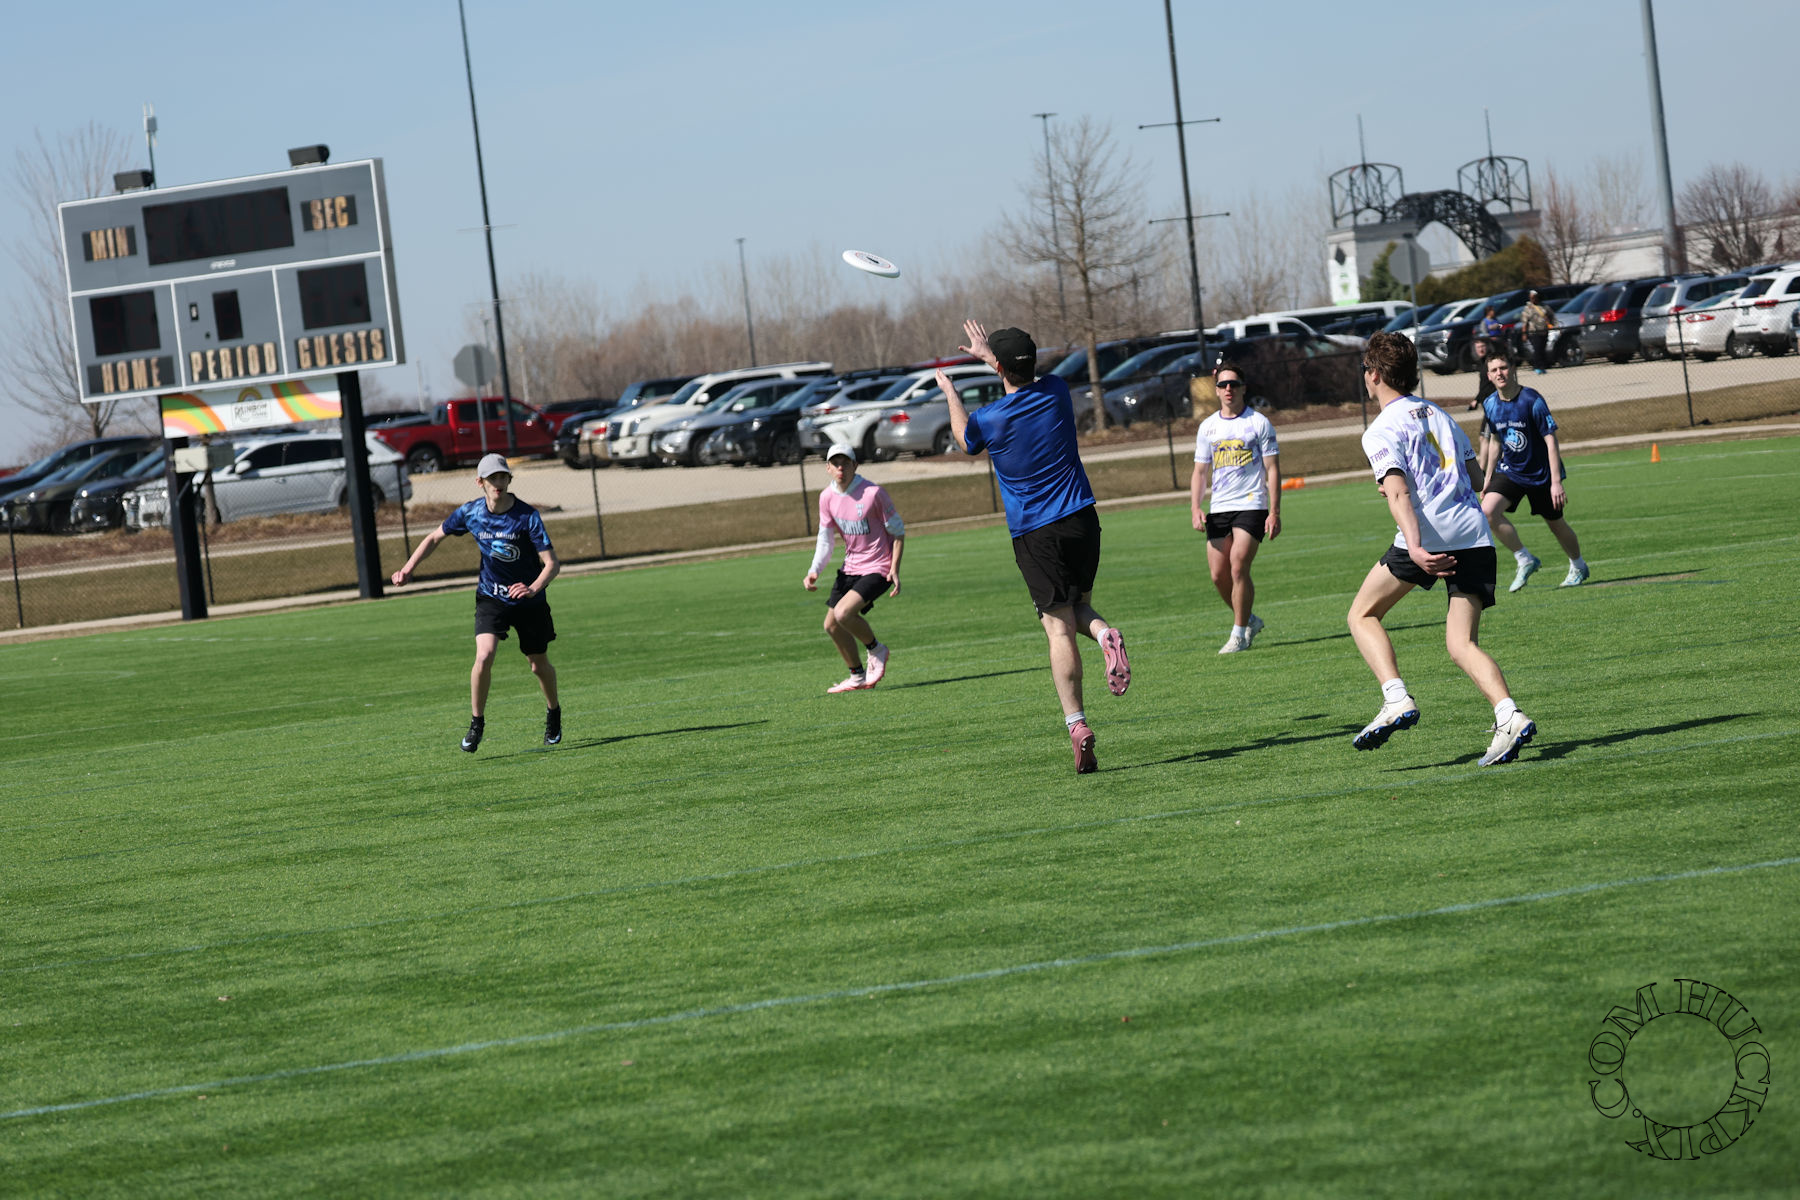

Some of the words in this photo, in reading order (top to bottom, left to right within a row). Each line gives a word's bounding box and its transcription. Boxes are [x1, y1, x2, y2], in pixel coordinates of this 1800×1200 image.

[310, 195, 348, 230] SEC
[90, 227, 129, 261] MIN
[190, 342, 278, 383] PERIOD
[297, 328, 385, 370] GUESTS
[101, 356, 161, 394] HOME
